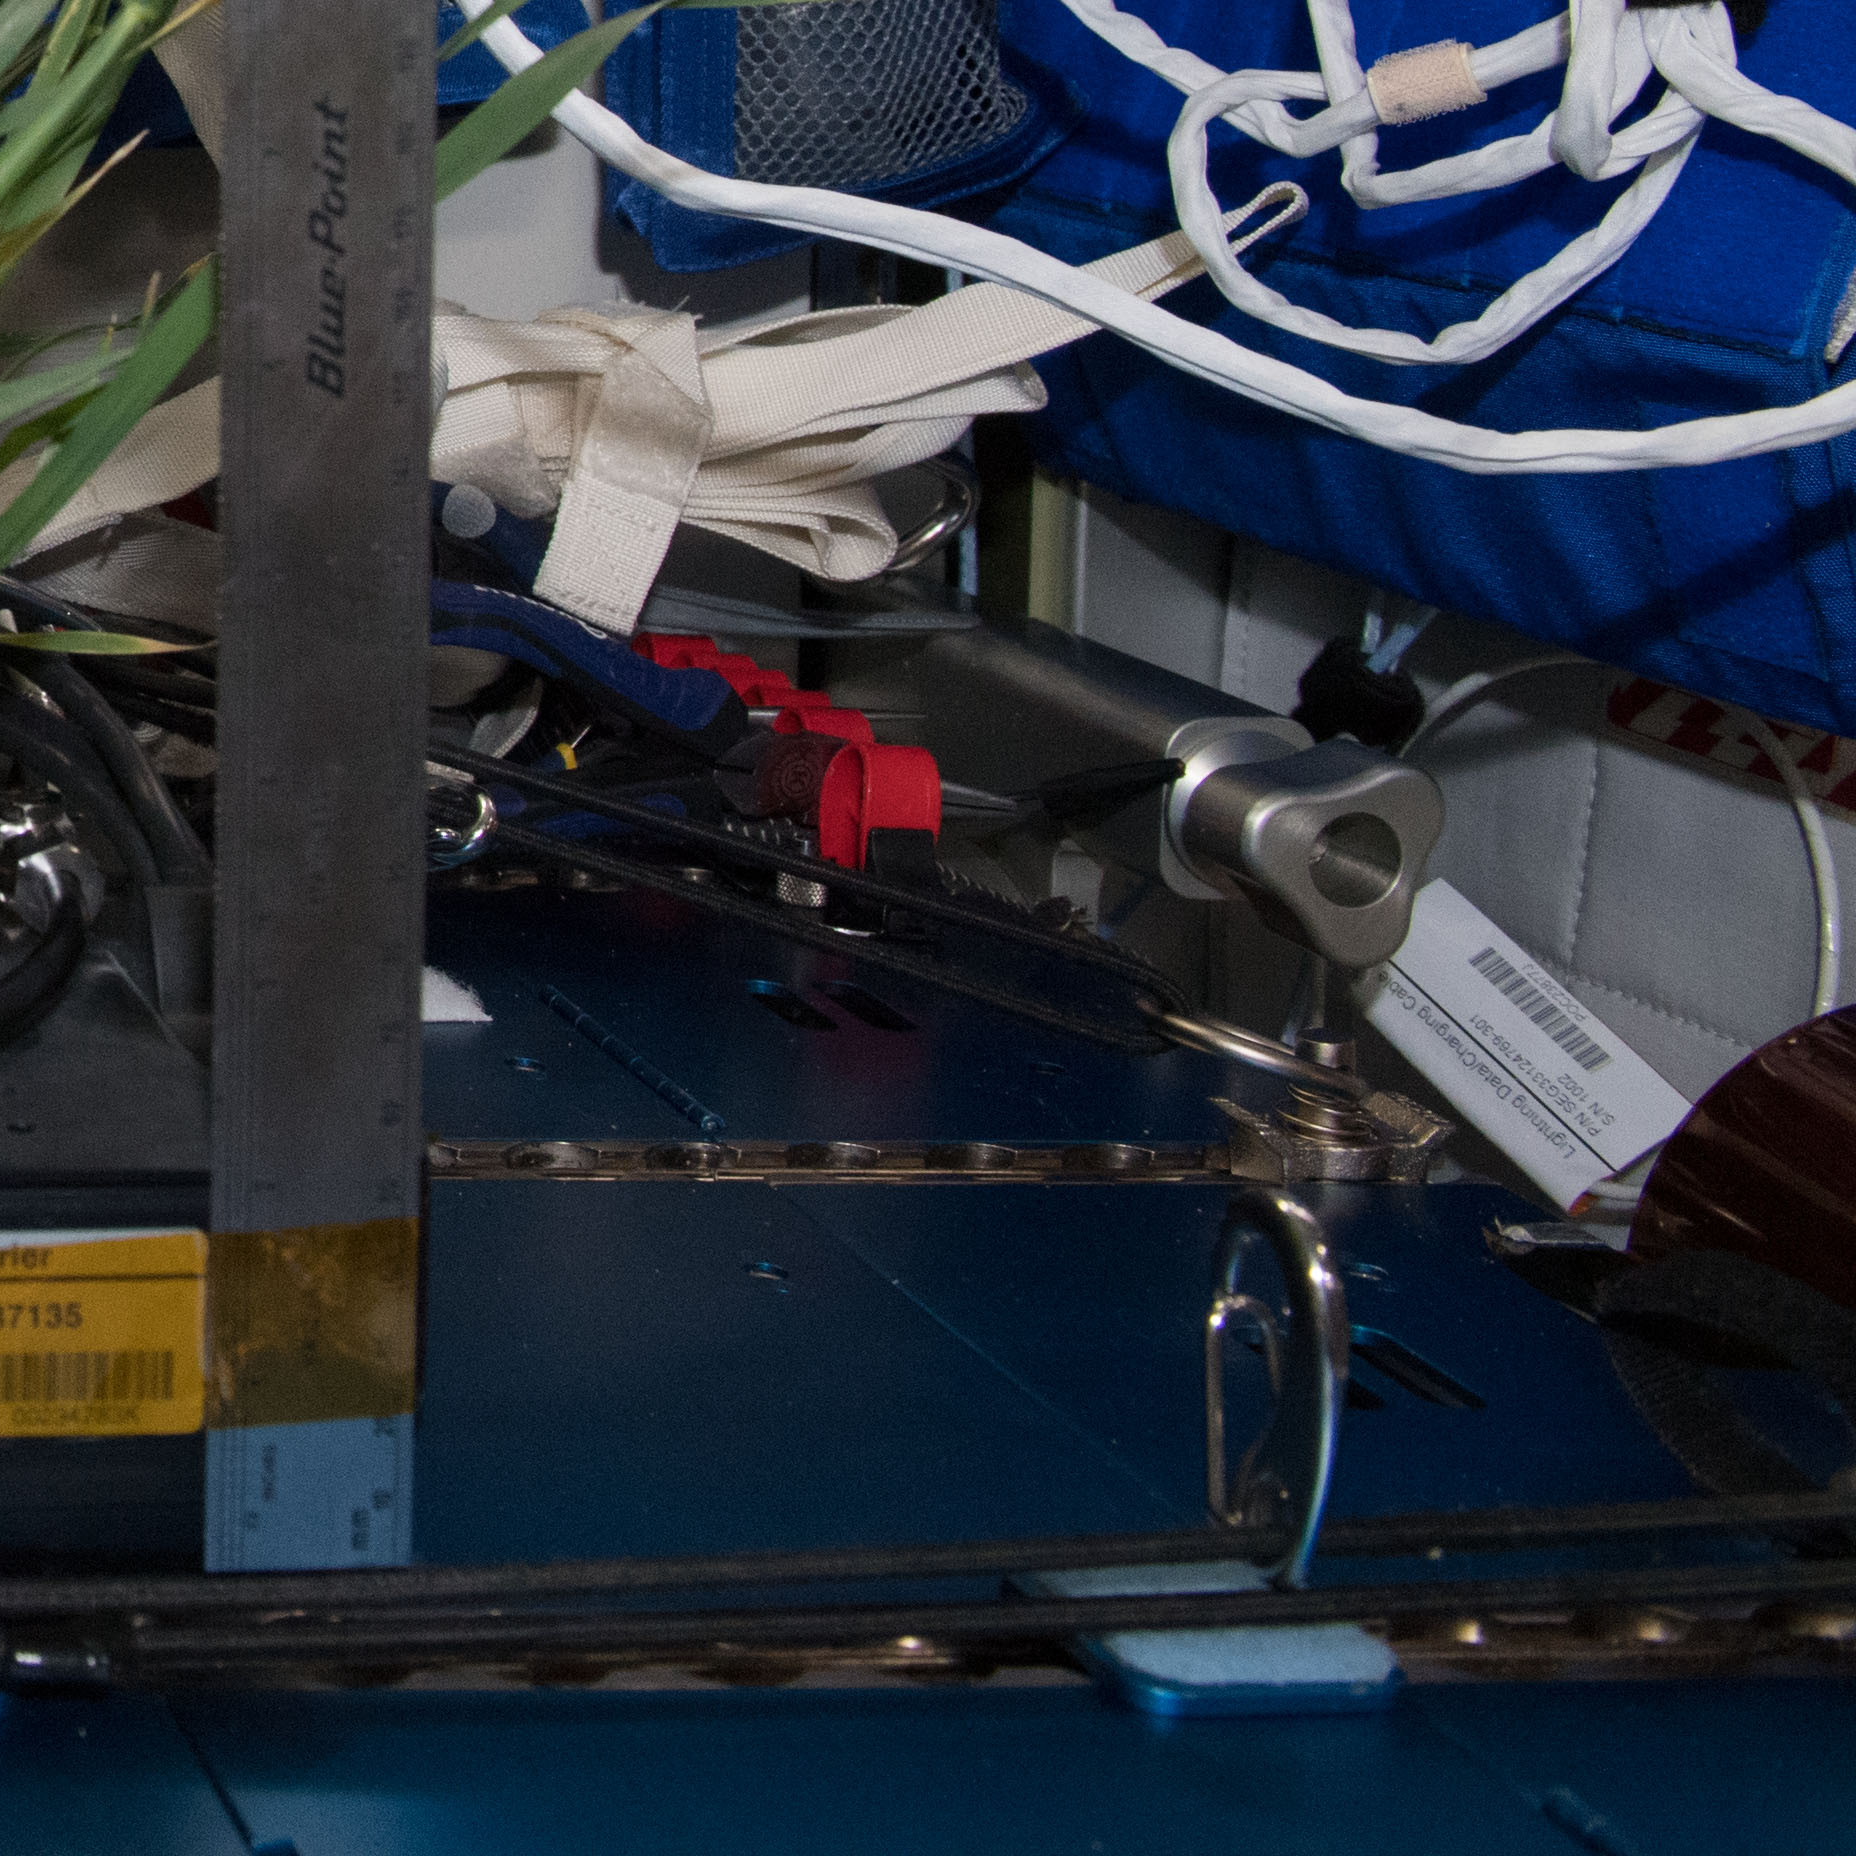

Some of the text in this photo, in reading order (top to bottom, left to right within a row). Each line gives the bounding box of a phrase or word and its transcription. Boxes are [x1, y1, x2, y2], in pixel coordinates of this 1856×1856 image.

[1375, 969, 1578, 1162] Lightning Data/Charging Cable
[1556, 1071, 1616, 1128] S/N 1002
[1574, 1110, 1603, 1139] P/N
